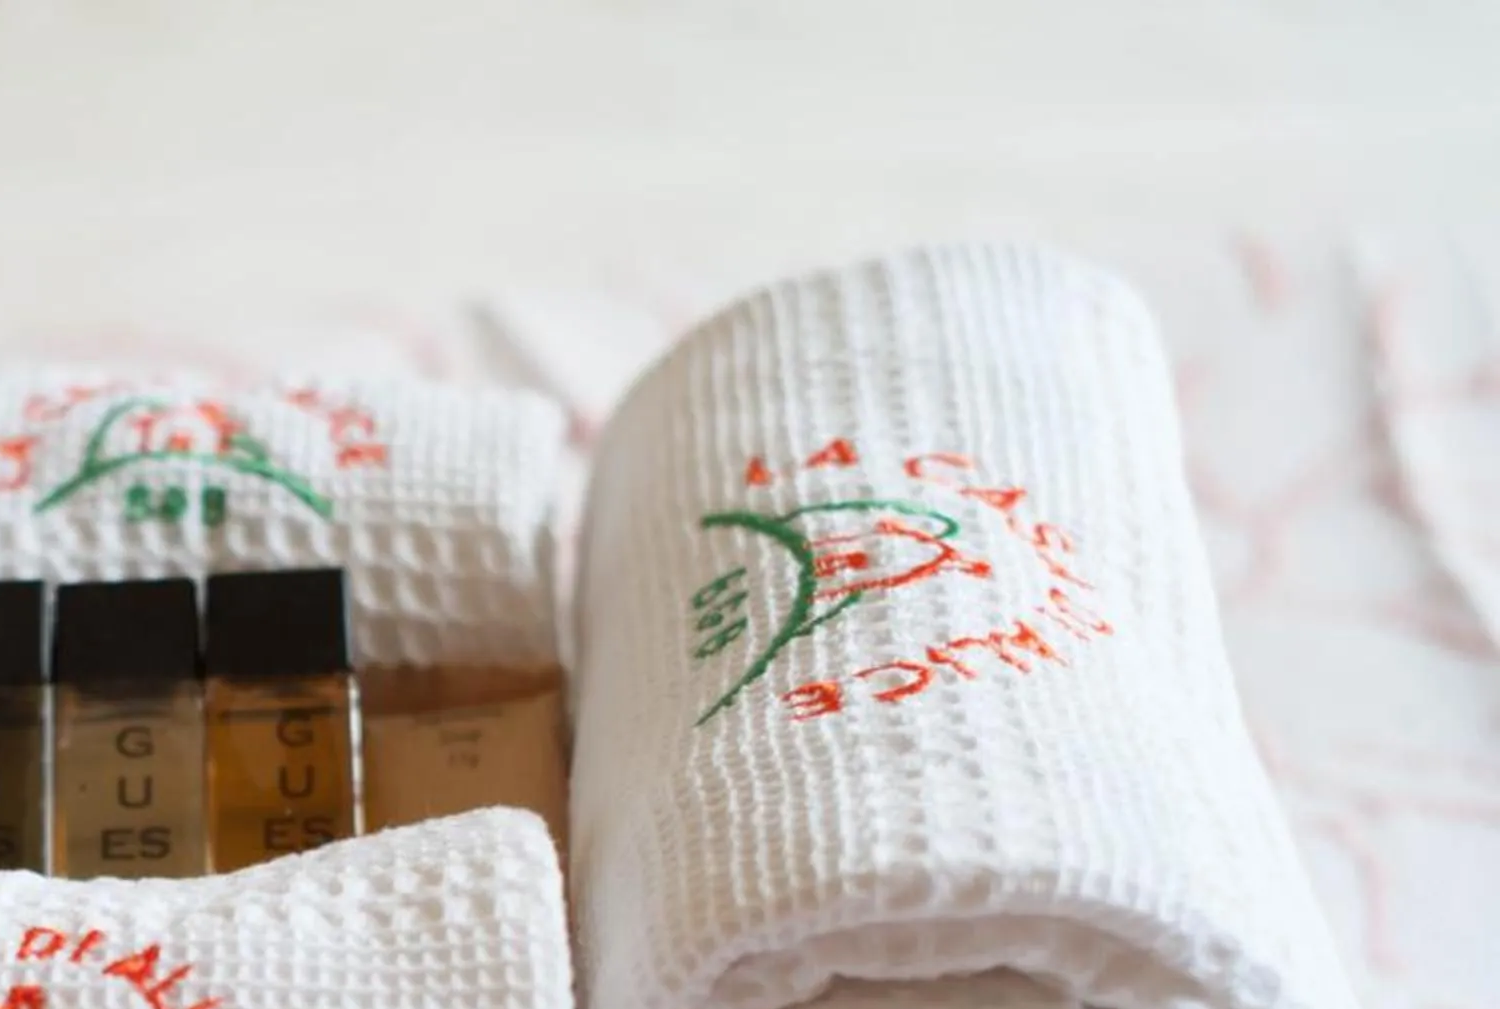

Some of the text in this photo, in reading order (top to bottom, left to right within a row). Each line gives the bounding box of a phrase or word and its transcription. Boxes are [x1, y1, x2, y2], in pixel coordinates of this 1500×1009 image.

[115, 725, 155, 760] G
[117, 775, 154, 809] U
[101, 827, 172, 861] ES
[16, 926, 106, 962] DI
